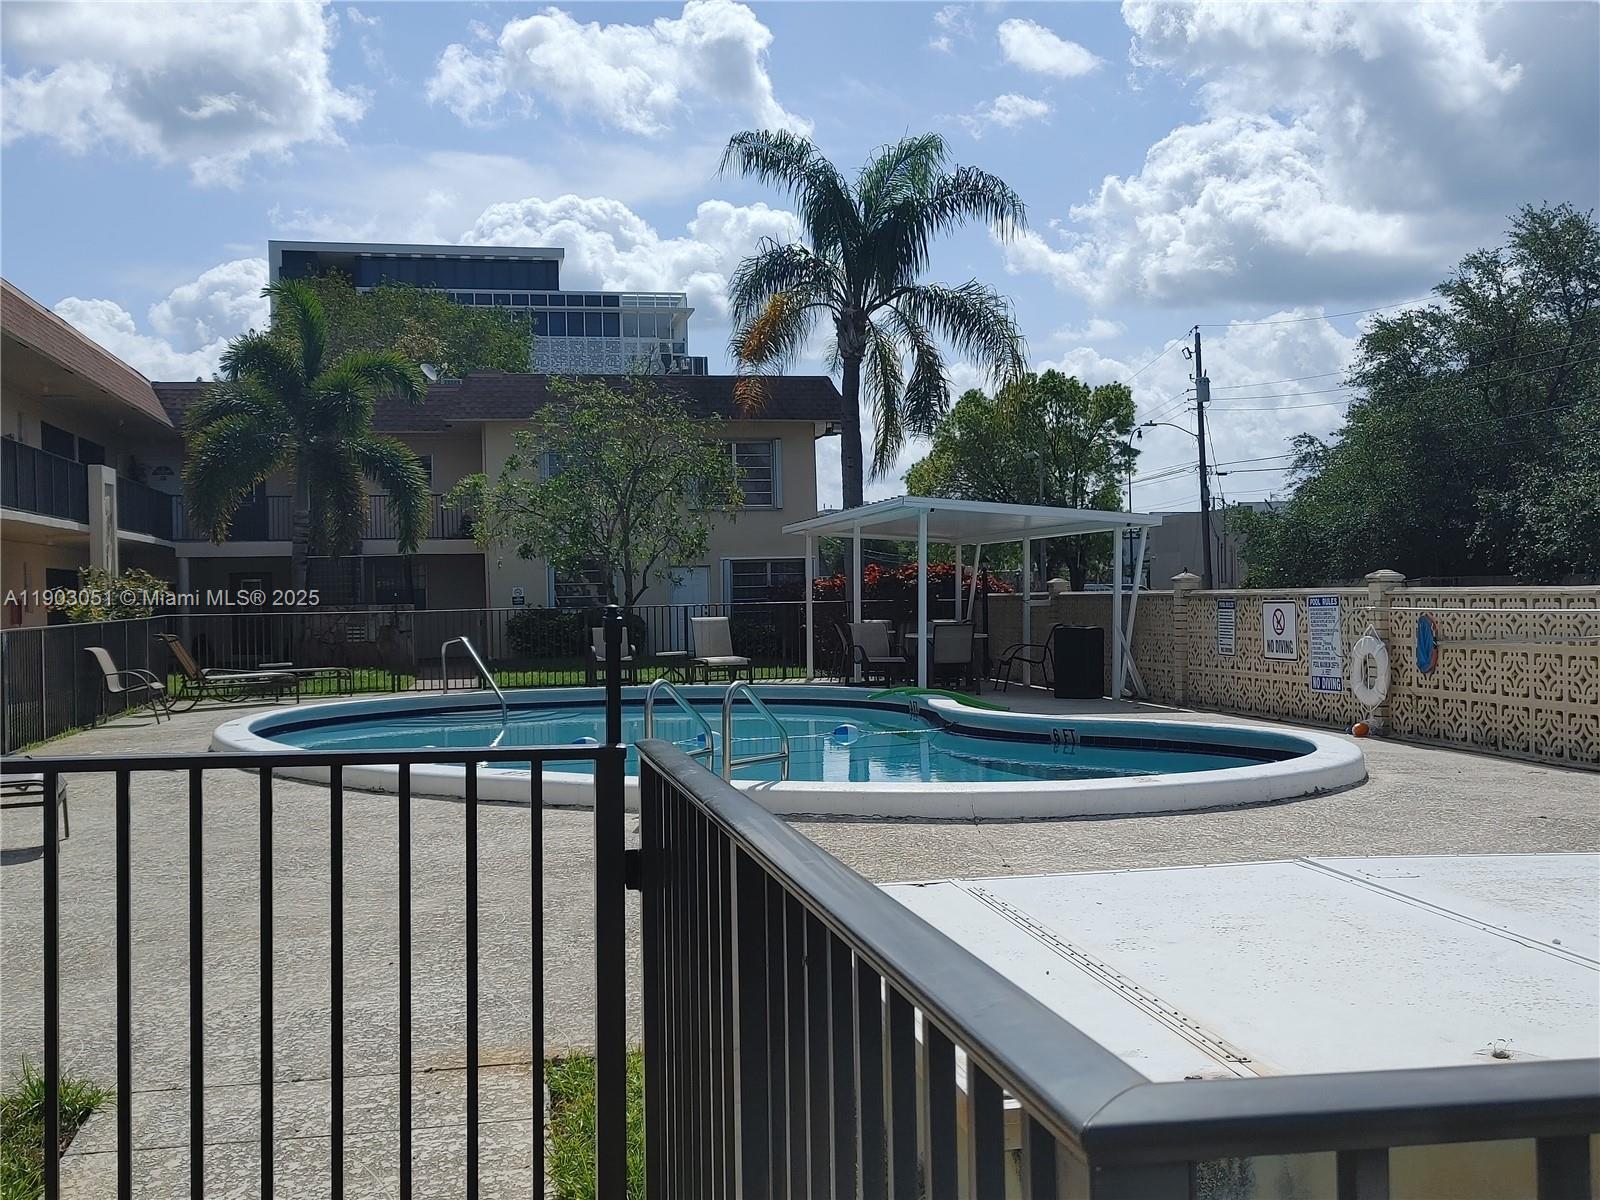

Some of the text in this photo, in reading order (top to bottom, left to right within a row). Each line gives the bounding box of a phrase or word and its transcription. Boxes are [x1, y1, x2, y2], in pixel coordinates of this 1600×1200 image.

[1309, 598, 1338, 606] POOL RULES
[1266, 639, 1294, 654] NO DIVING
[1312, 677, 1341, 690] NO DIVING
[1062, 728, 1075, 745] FT
